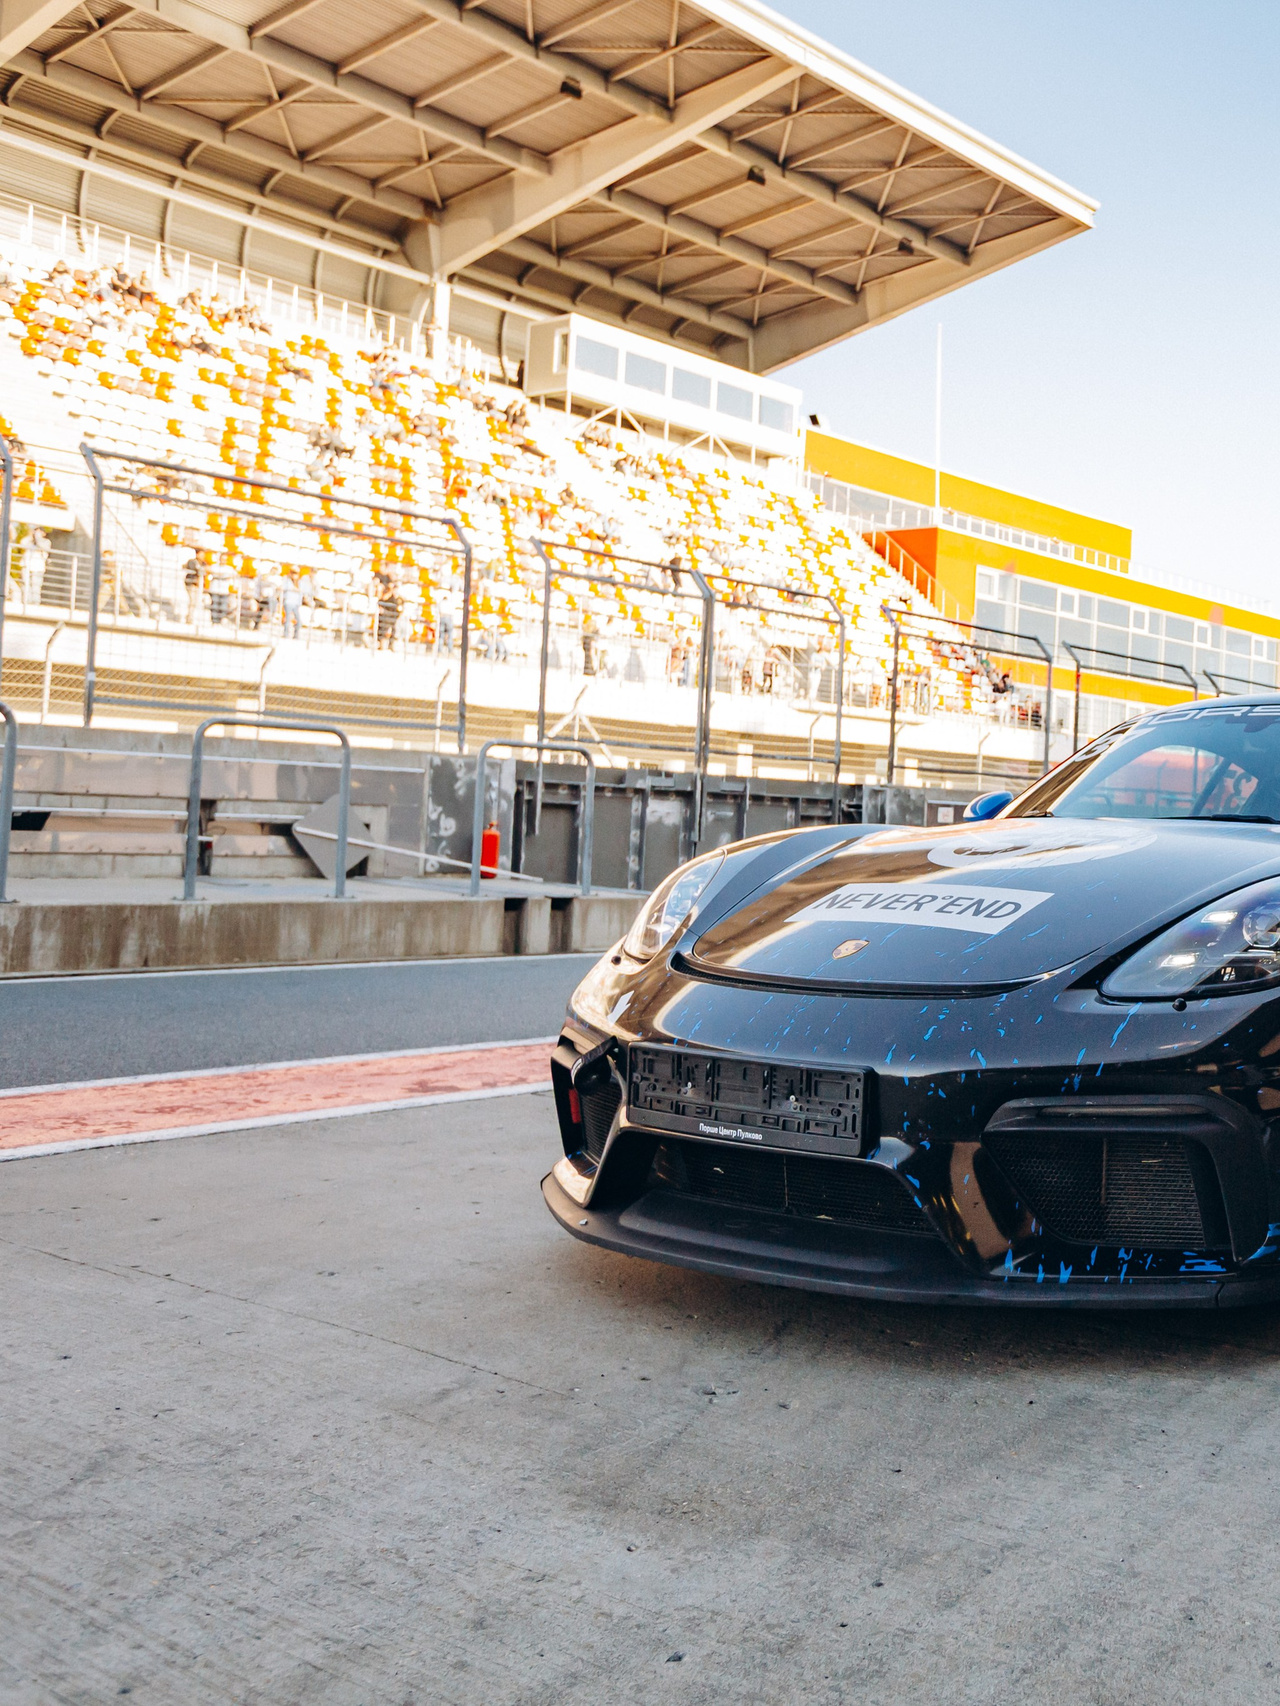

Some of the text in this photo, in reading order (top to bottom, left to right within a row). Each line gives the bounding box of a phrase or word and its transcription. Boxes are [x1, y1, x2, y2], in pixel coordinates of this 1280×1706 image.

[699, 1123, 763, 1140] Порше Центр Пулково
